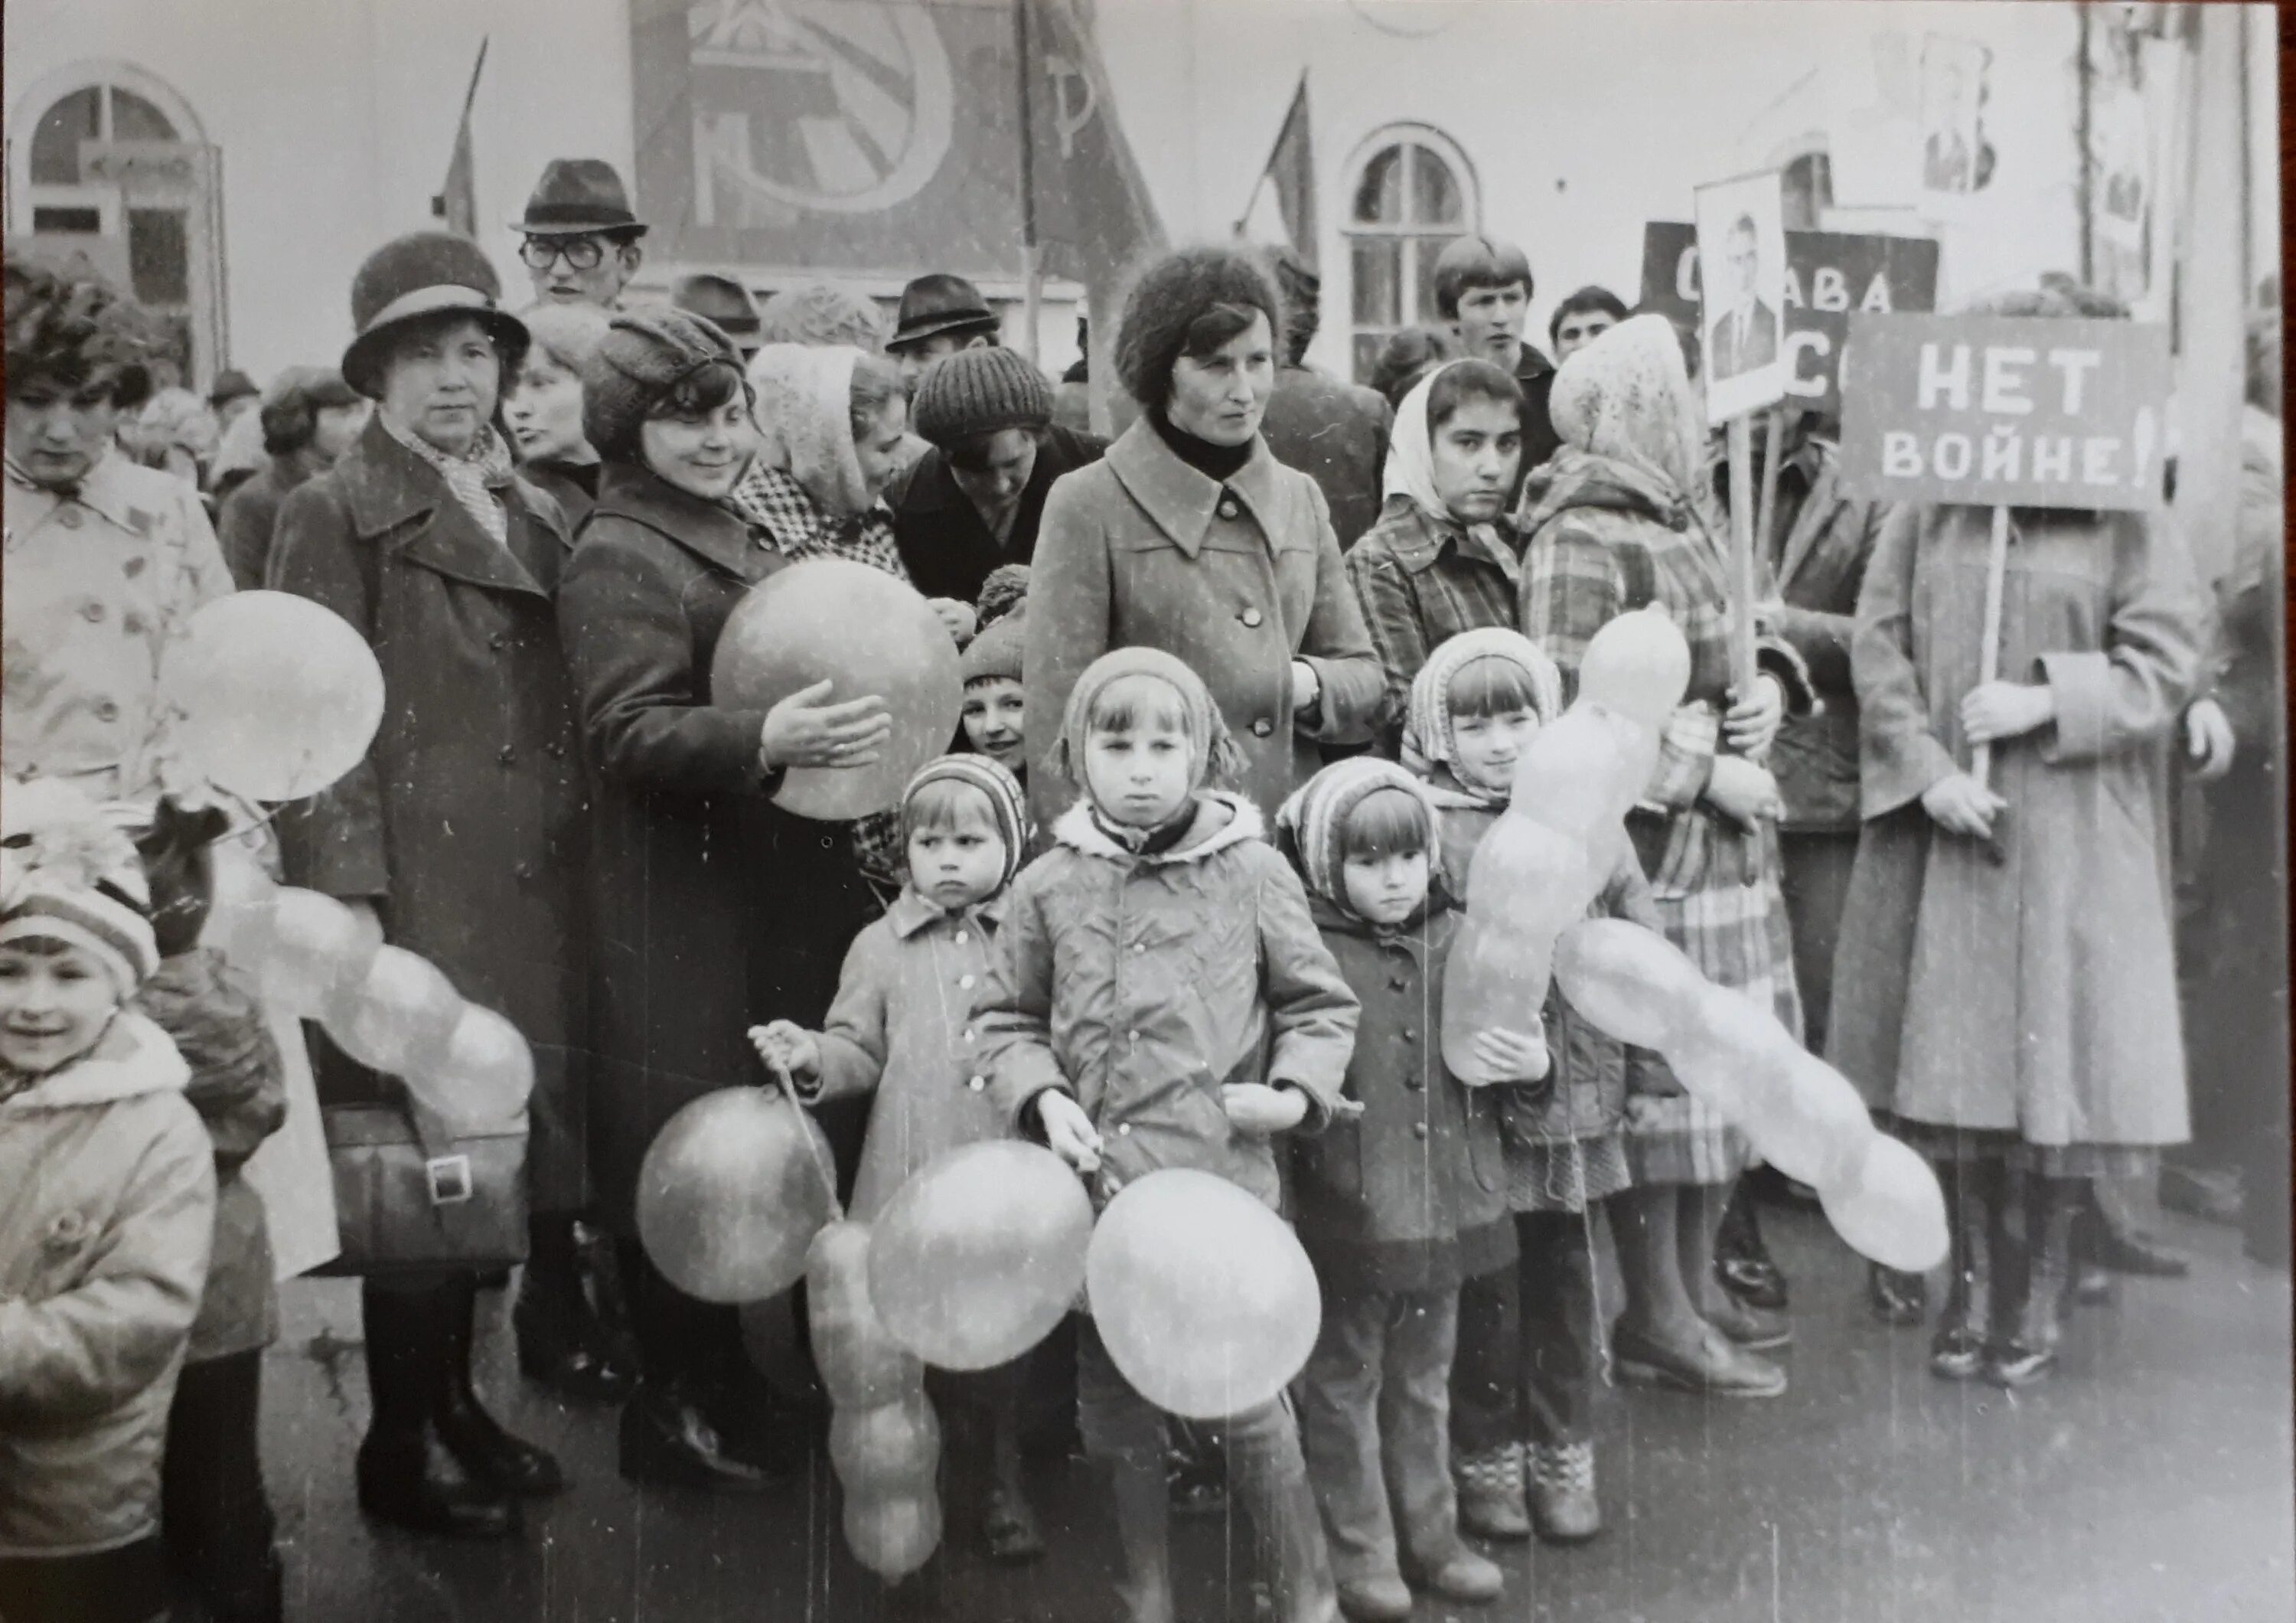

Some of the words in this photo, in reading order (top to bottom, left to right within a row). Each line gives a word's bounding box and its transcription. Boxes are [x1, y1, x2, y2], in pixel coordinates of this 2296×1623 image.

[1676, 246, 1892, 312] САВА
[1918, 343, 2100, 416] НЕТ
[1883, 405, 2155, 488] ВОЙНЕ!
